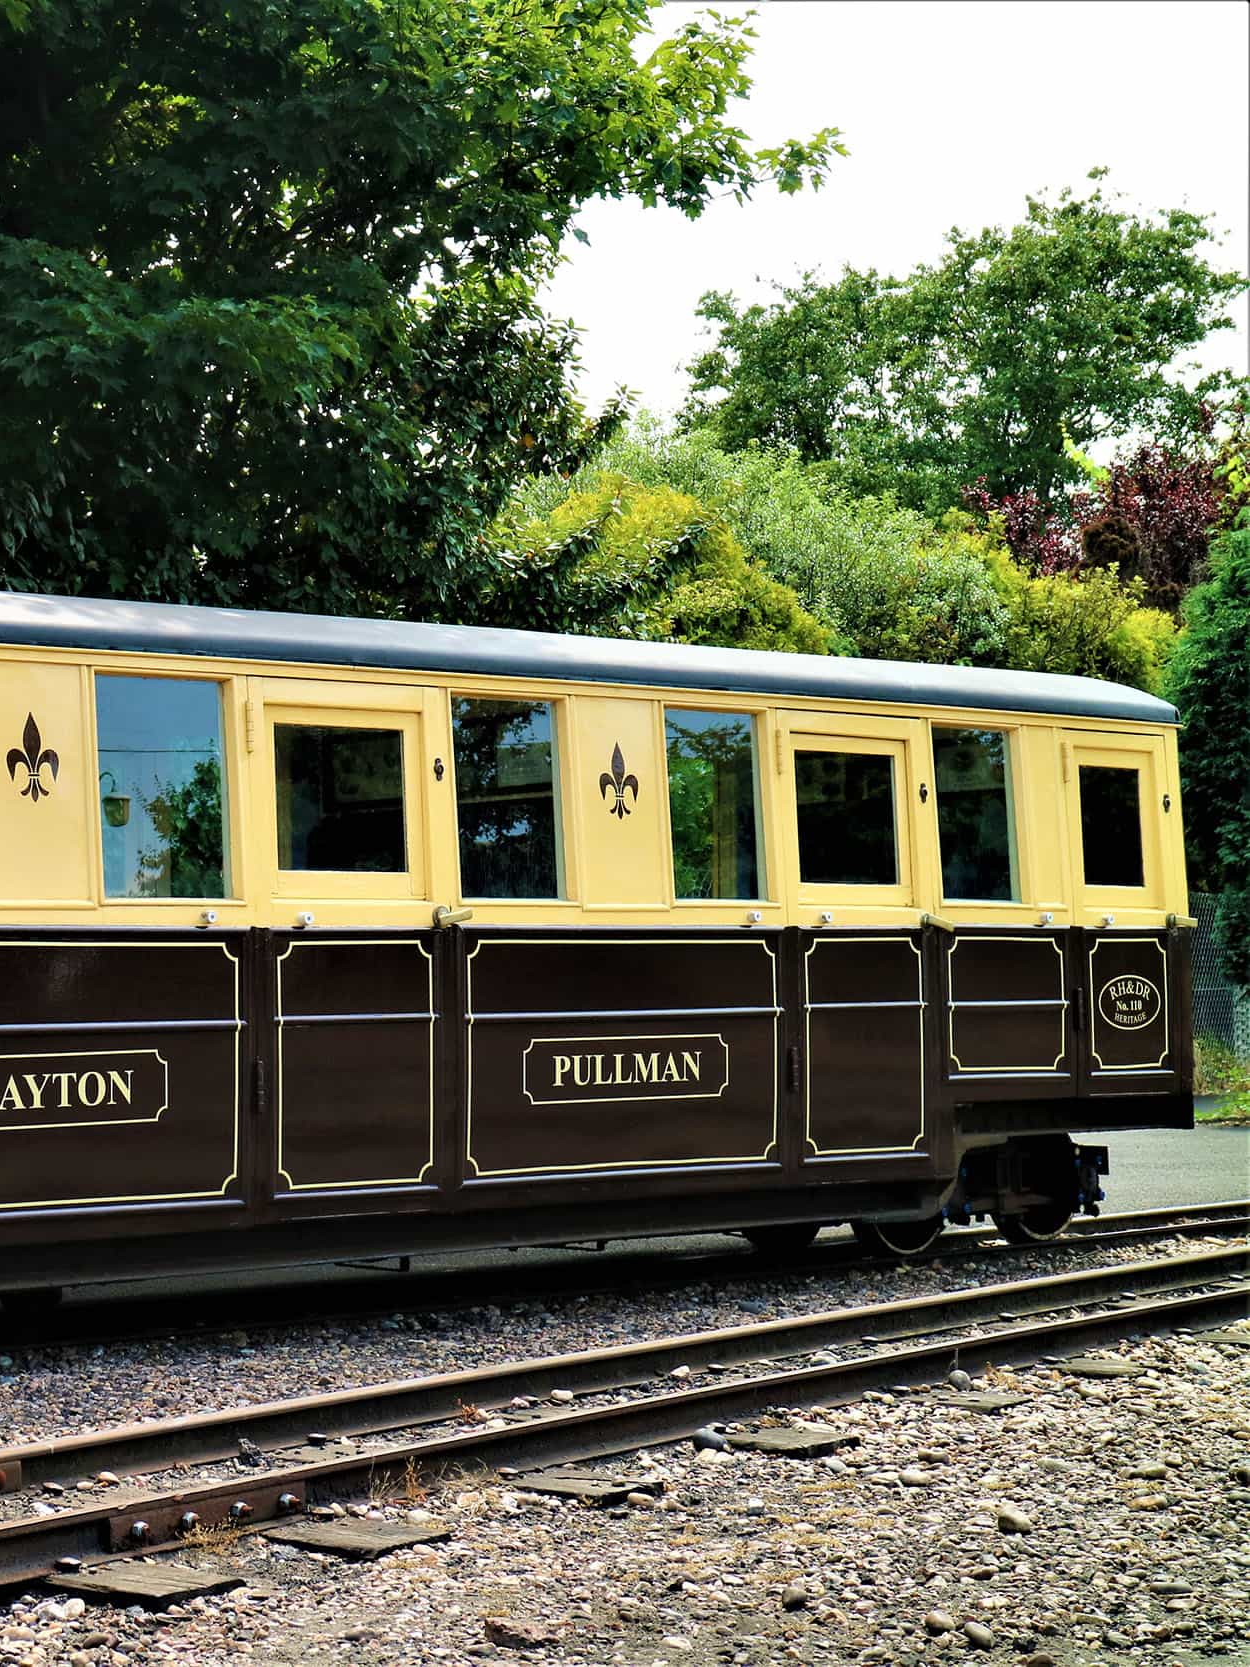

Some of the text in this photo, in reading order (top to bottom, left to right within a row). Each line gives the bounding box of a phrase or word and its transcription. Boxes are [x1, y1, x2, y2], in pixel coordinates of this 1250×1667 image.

[1110, 980, 1150, 1000] RH&DR
[1116, 1000, 1143, 1011] No. 110
[1114, 1011, 1147, 1024] HERITAGE
[552, 1050, 703, 1087] PULLMAN
